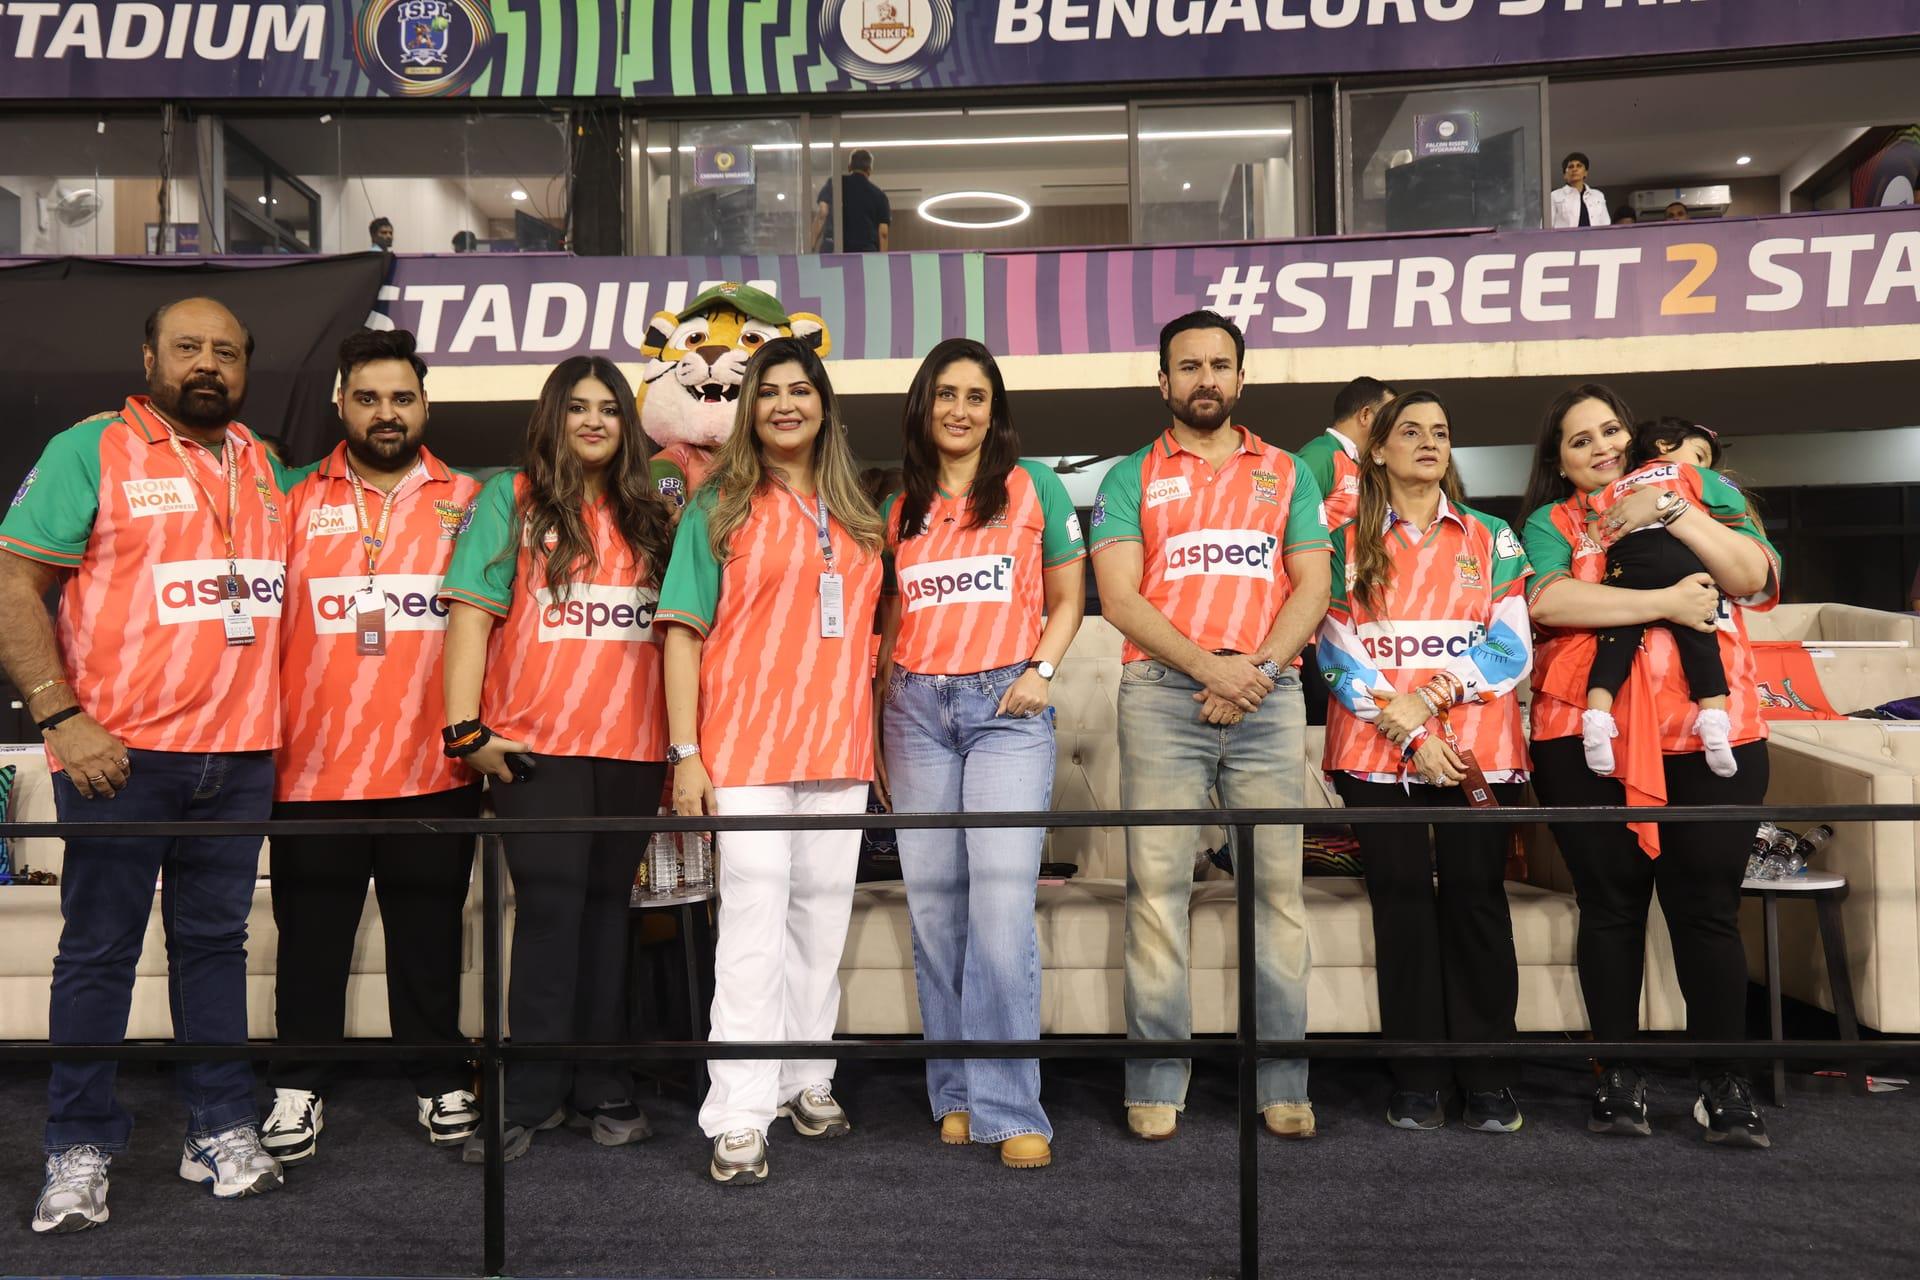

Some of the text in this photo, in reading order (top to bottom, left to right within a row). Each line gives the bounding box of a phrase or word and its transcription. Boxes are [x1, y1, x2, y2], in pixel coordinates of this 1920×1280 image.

[0, 3, 326, 60] TADIUM
[1202, 231, 1920, 334] #STREET 2 STA
[364, 280, 777, 353] TADIU
[126, 480, 177, 495] NOM
[130, 492, 181, 508] NOM
[1148, 486, 1180, 501] NOM
[312, 506, 344, 518] OM
[1169, 542, 1269, 572] aspect
[162, 575, 284, 608] asec
[907, 564, 1006, 603] aspect
[317, 592, 449, 620] aec
[543, 600, 655, 637] aspec
